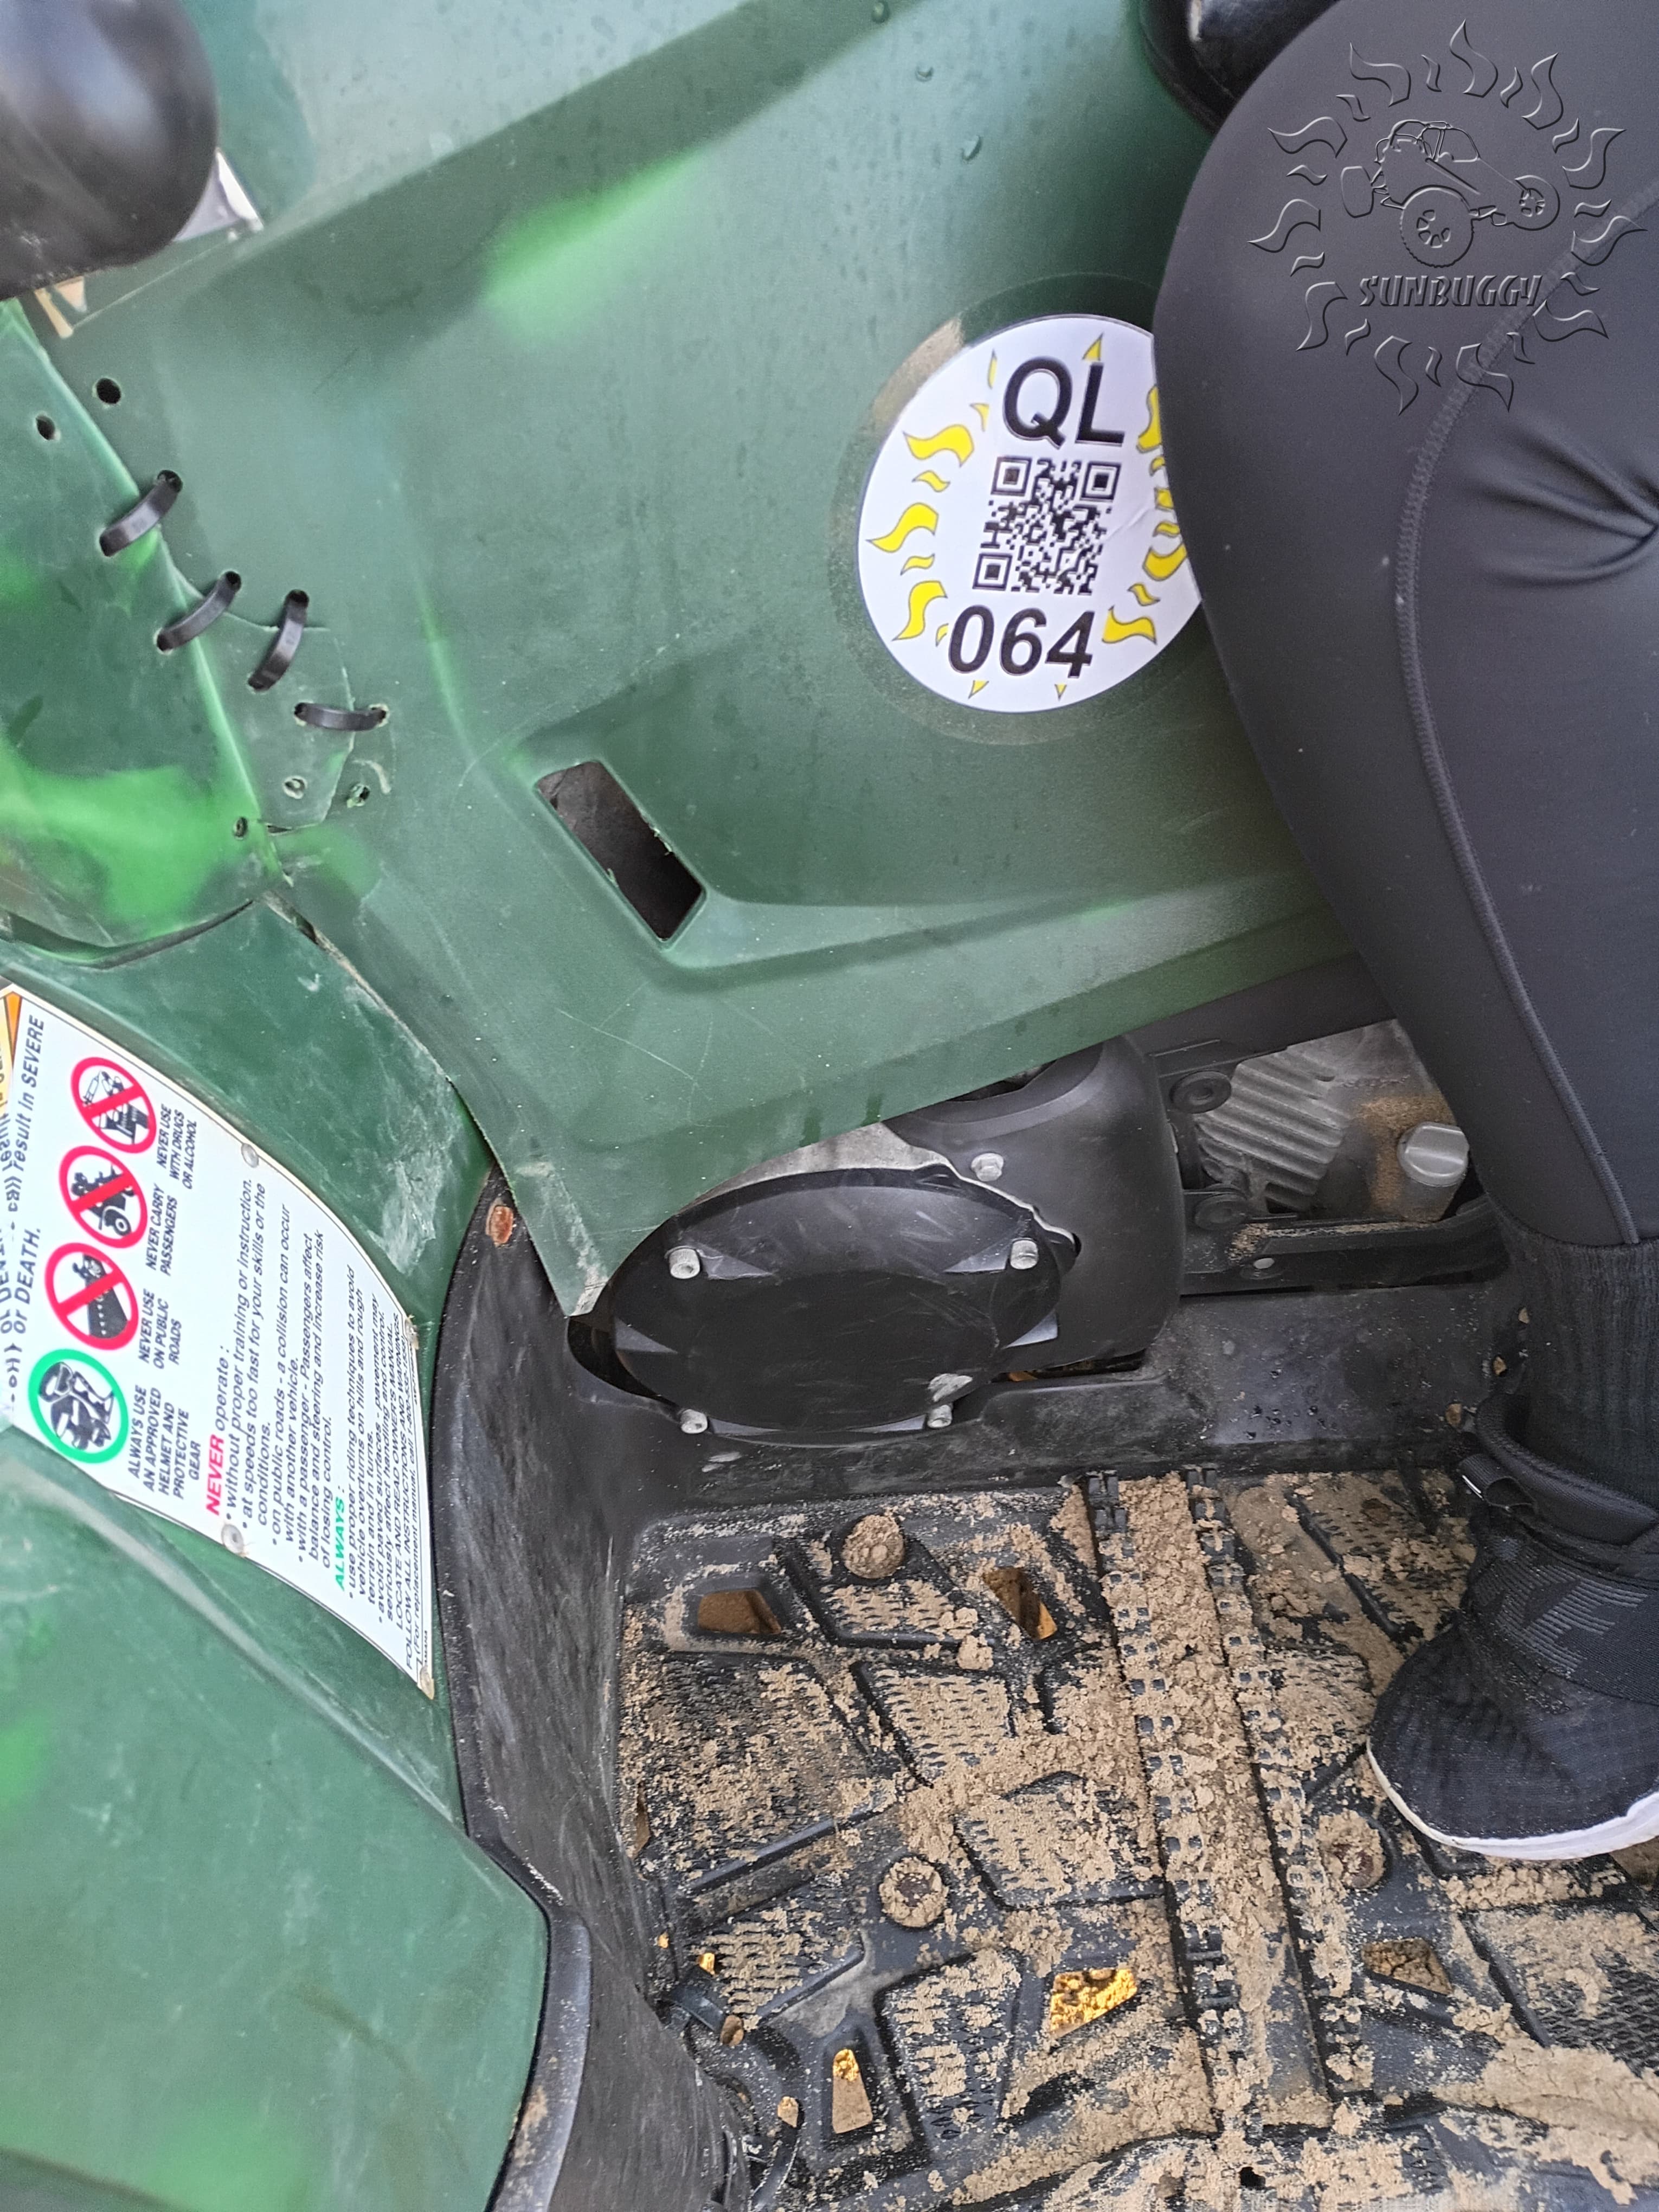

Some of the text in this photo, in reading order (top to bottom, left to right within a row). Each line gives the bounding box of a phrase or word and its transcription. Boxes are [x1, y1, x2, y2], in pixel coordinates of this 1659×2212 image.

[1003, 356, 1126, 449] QL
[948, 605, 1094, 679] 064
[21, 1015, 44, 1088] SEVERE
[18, 1092, 34, 1111] in
[156, 1104, 171, 1168] NEVER USE
[12, 1114, 31, 1171] result
[169, 1109, 184, 1180] WITH DRUGS
[182, 1120, 197, 1189] OR ALCOHOL
[145, 1183, 164, 1271] NEVER CARRY
[160, 1195, 177, 1276] PASSENGERS
[279, 1203, 291, 1251] occur
[303, 1233, 313, 1279] affect
[14, 1228, 41, 1334] or DEATH.
[280, 1254, 288, 1284] can
[138, 1288, 155, 1364] NEVER USE
[153, 1298, 169, 1369] ON PUBLIC
[168, 1319, 182, 1365] ROADS
[226, 1179, 252, 1508] without proper training or instruction.
[276, 1287, 288, 1358] collision
[300, 1282, 313, 1380] Passengers
[348, 1313, 355, 1328] to
[356, 1288, 364, 1336] rough
[241, 1183, 265, 1518] at speeds too fast for your skills or the
[277, 1361, 286, 1374] a
[347, 1333, 357, 1425] techniques
[372, 1329, 382, 1411] pavement
[387, 1323, 396, 1388] MANUAL.
[274, 1388, 285, 1441] roads
[308, 1229, 324, 1561] balance and steering and increase risk
[356, 1373, 364, 1409] hills
[358, 1412, 364, 1435] on
[390, 1388, 399, 1464] OWNER'S
[128, 1385, 146, 1479] ALWAYS USE
[143, 1387, 162, 1492] AN APPROVED
[158, 1402, 175, 1495] HELMET AND
[173, 1409, 189, 1500] PROTECTIVE
[189, 1441, 201, 1480] GEAR
[206, 1435, 224, 1516] NEVER
[215, 1357, 229, 1431] operate
[284, 1358, 298, 1542] with another vehicle.
[299, 1393, 311, 1493] passenger
[347, 1429, 357, 1482] riding
[375, 1422, 383, 1496] surfaces
[382, 1405, 390, 1478] handling
[257, 1423, 271, 1526] conditions.
[271, 1445, 284, 1506] public
[299, 1494, 307, 1507] a
[320, 1417, 333, 1569] of losing control.
[366, 1482, 374, 1500] in
[383, 1481, 392, 1532] affect
[400, 1431, 410, 1554] INSTRUCTIONS
[272, 1509, 281, 1535] on
[297, 1511, 306, 1551] with
[335, 1496, 344, 1591] ALWAYS
[348, 1483, 357, 1551] proper
[375, 1499, 385, 1559] paved
[357, 1529, 365, 1594] vehicle
[367, 1543, 375, 1605] terrain
[384, 1535, 394, 1622] seriously
[395, 1557, 403, 1630] LOCATE
[412, 1525, 420, 1618] replacement
